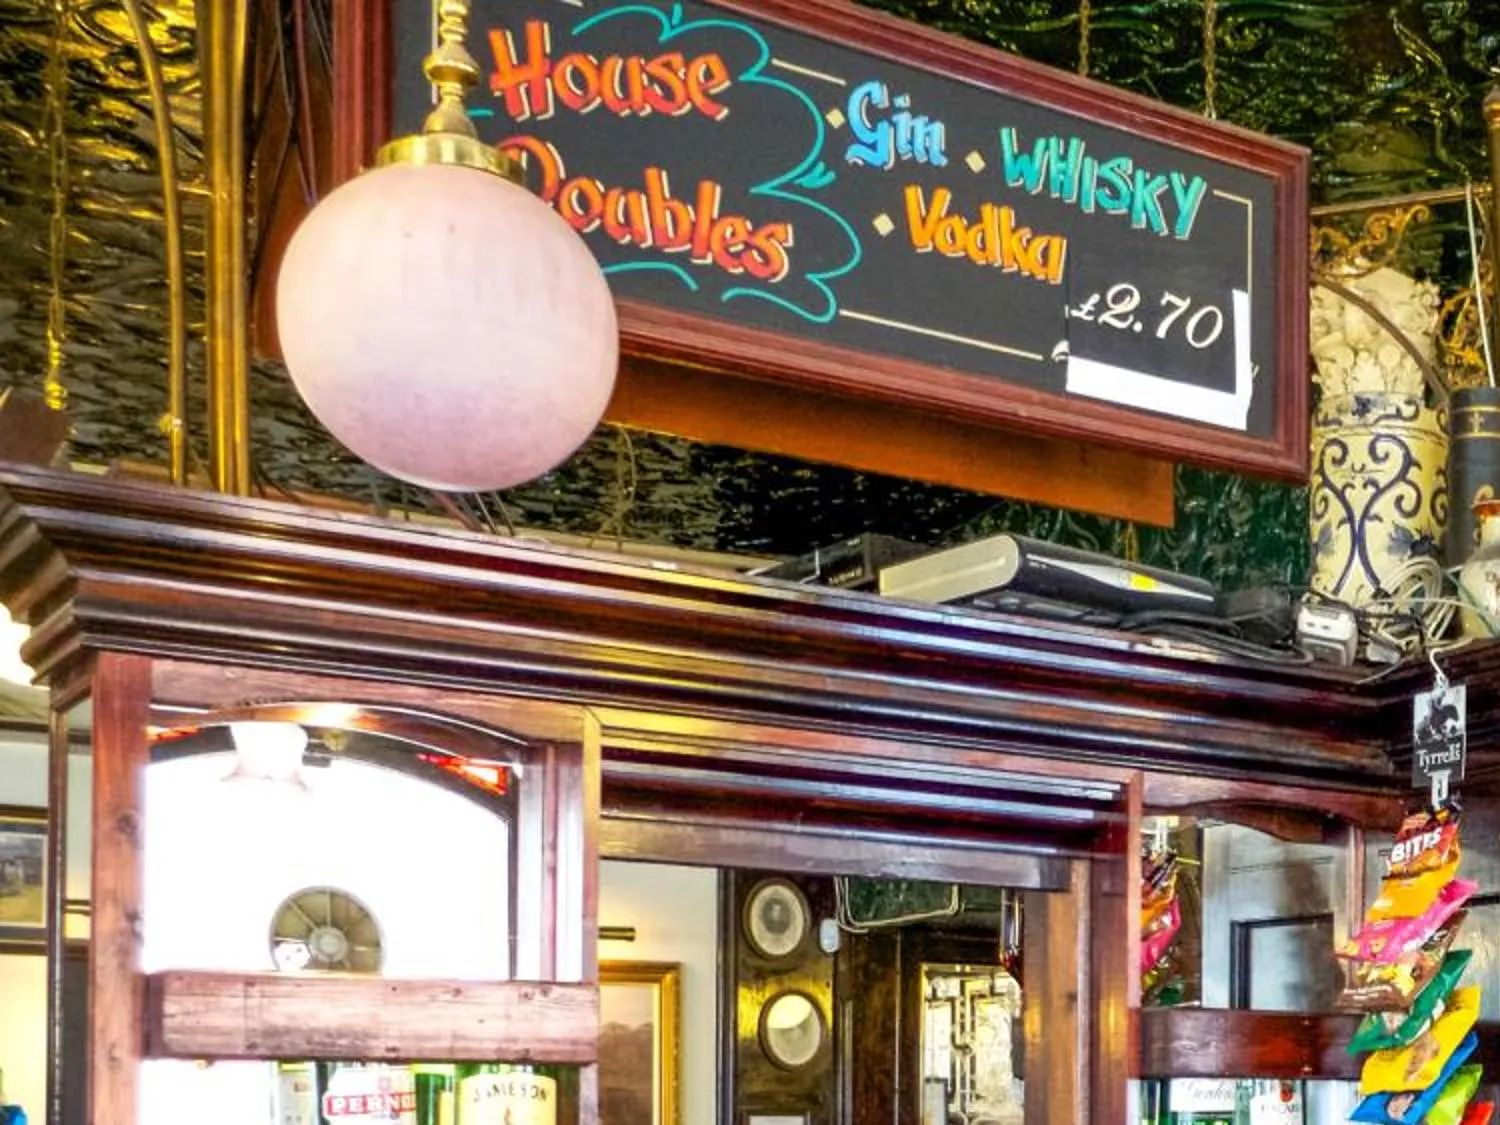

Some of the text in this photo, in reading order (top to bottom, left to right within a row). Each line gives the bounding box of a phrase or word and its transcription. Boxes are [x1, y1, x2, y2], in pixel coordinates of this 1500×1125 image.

[489, 19, 733, 123] House
[848, 82, 1210, 241] Gin WHISKY
[904, 184, 1068, 285] Vodka
[1070, 280, 1223, 351] £2.70
